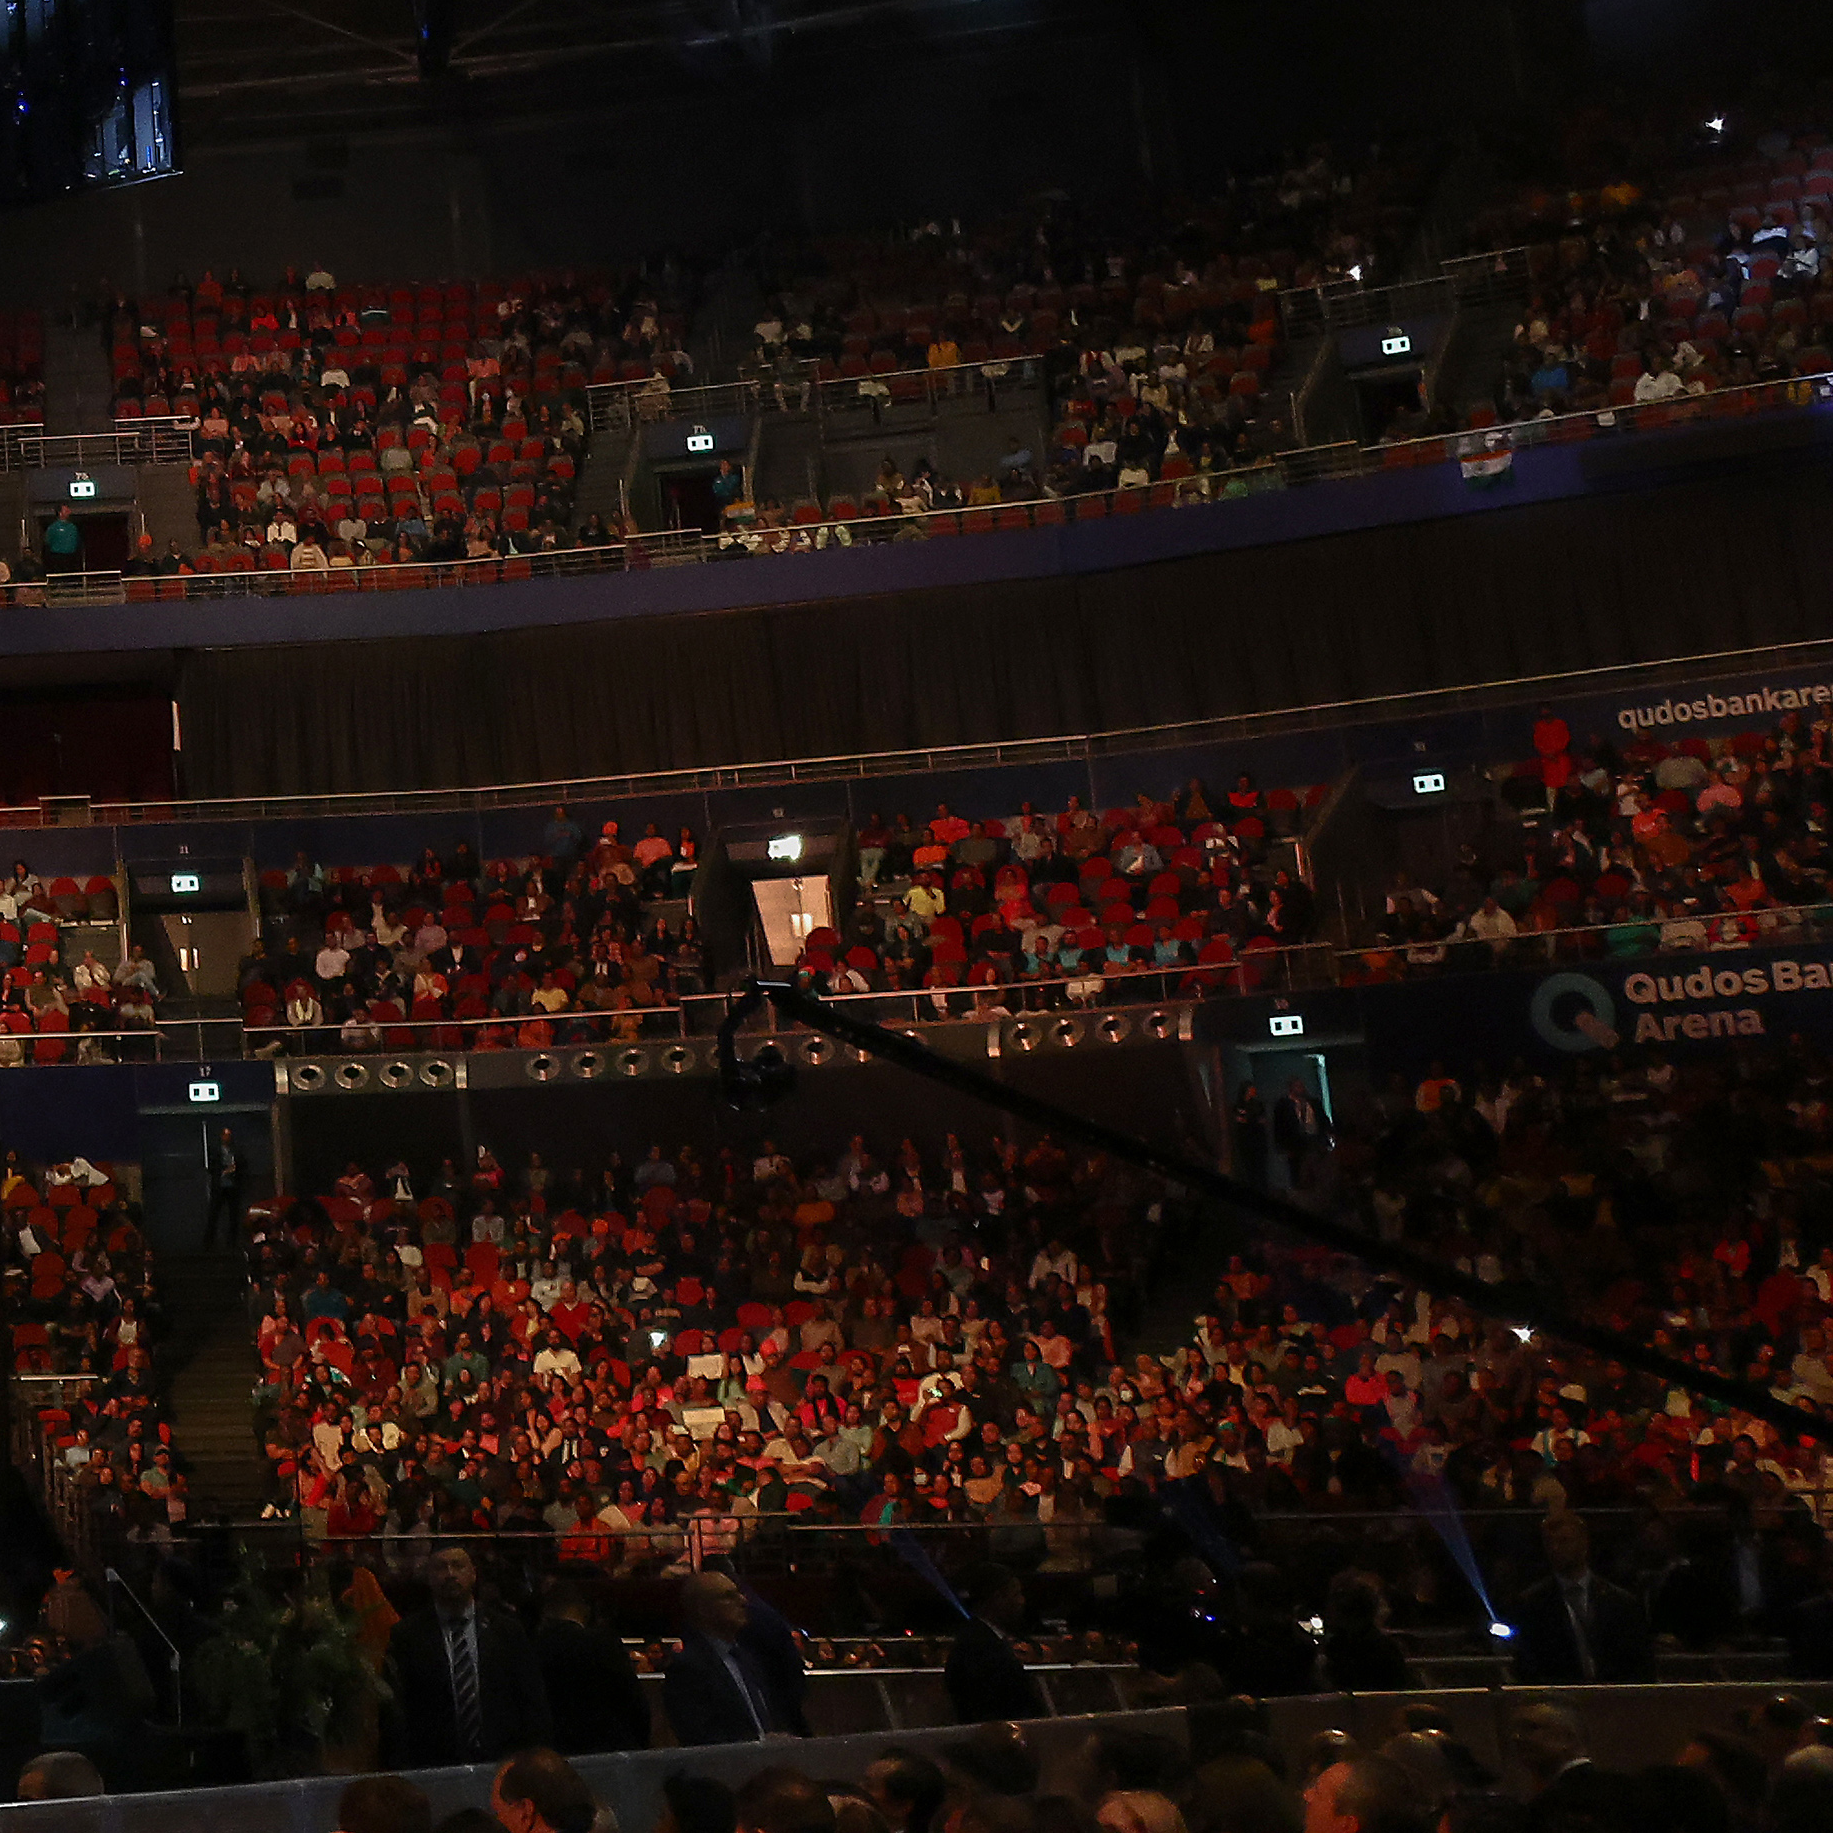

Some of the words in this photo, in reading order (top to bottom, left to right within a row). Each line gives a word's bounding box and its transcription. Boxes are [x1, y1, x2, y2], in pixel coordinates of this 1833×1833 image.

[1617, 684, 1833, 734] qudosbankare
[1624, 965, 1770, 1004] Qudos
[1771, 960, 1833, 992] Ba
[1635, 1008, 1767, 1044] Arena
